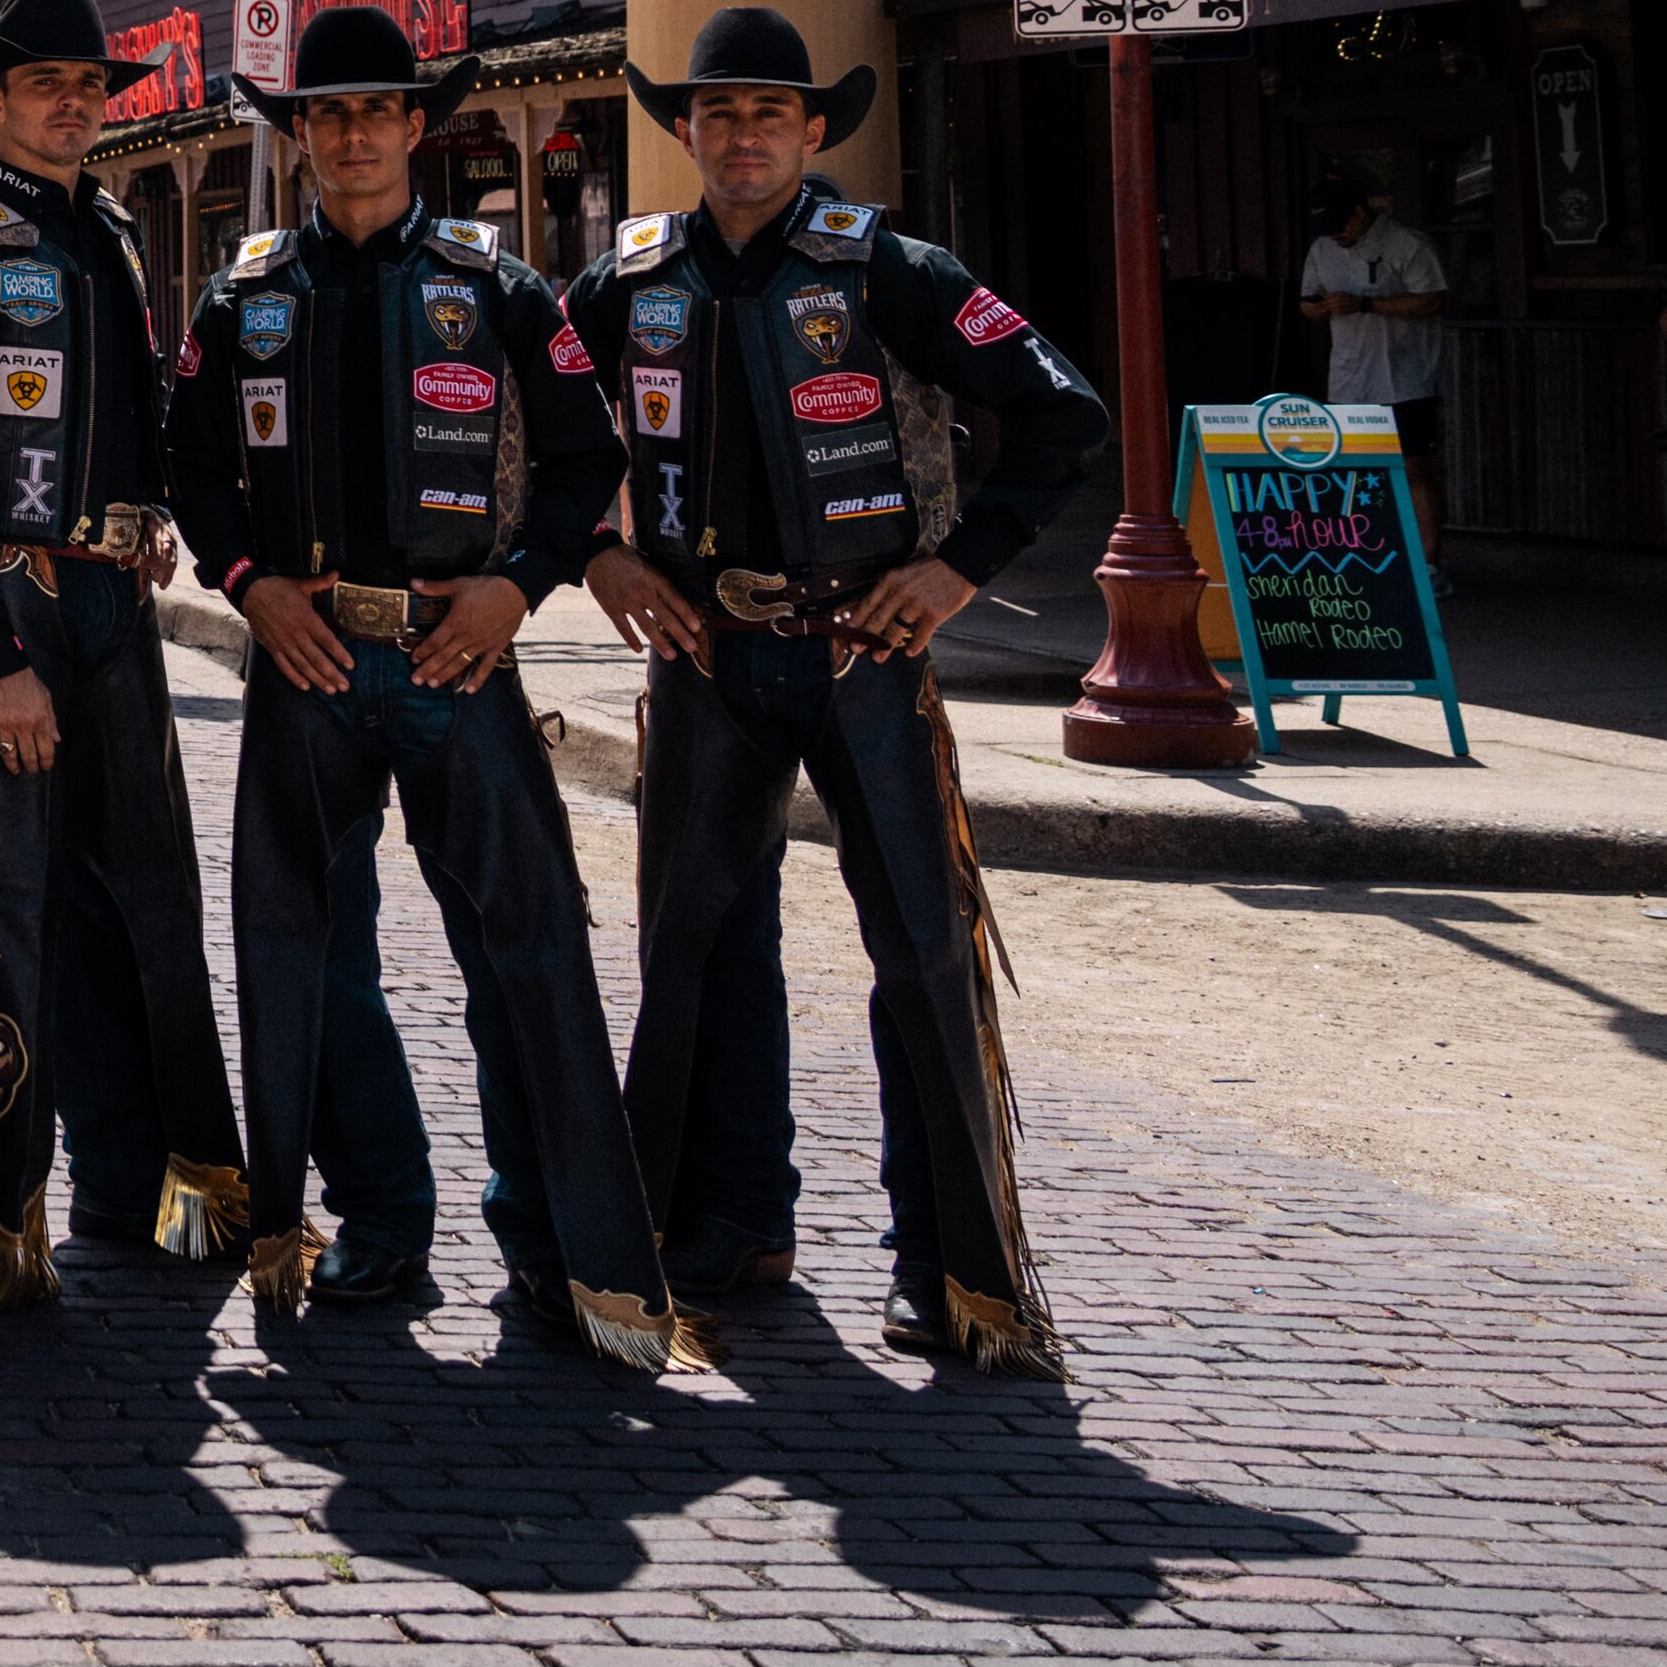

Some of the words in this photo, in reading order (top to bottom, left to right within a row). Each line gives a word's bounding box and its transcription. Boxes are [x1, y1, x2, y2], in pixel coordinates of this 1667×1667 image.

[240, 39, 283, 53] COMMERCIAL
[246, 51, 275, 62] LOADING
[252, 61, 270, 72] ZONE
[1538, 69, 1591, 96] OPEN
[547, 151, 578, 171] OPEN
[3, 274, 53, 289] CAMPING
[4, 282, 54, 297] WORLD
[422, 284, 475, 305] RATTLERS
[636, 302, 681, 316] CAMPING
[786, 291, 848, 320] RATTLERS
[245, 309, 285, 322] CAMPING
[636, 310, 680, 326] WORLD
[247, 317, 284, 331] WORLD
[634, 374, 679, 389] ARIAT
[245, 385, 283, 398] ARIAT
[419, 380, 490, 402] Community
[797, 386, 876, 411] Community
[1280, 404, 1310, 414] SUN
[1204, 416, 1219, 424] REAL
[1235, 416, 1249, 424] TEA
[1268, 416, 1328, 427] CRUISER
[1348, 416, 1364, 424] REAL
[428, 424, 489, 444] Land.com
[819, 437, 889, 462] Land.com
[420, 489, 487, 508] can-am
[1226, 471, 1357, 517] HAPPY
[825, 491, 905, 515] can-am
[11, 511, 51, 524] WHISKEY
[1309, 597, 1371, 621] Rodeo
[1330, 625, 1403, 651] Rodeo
